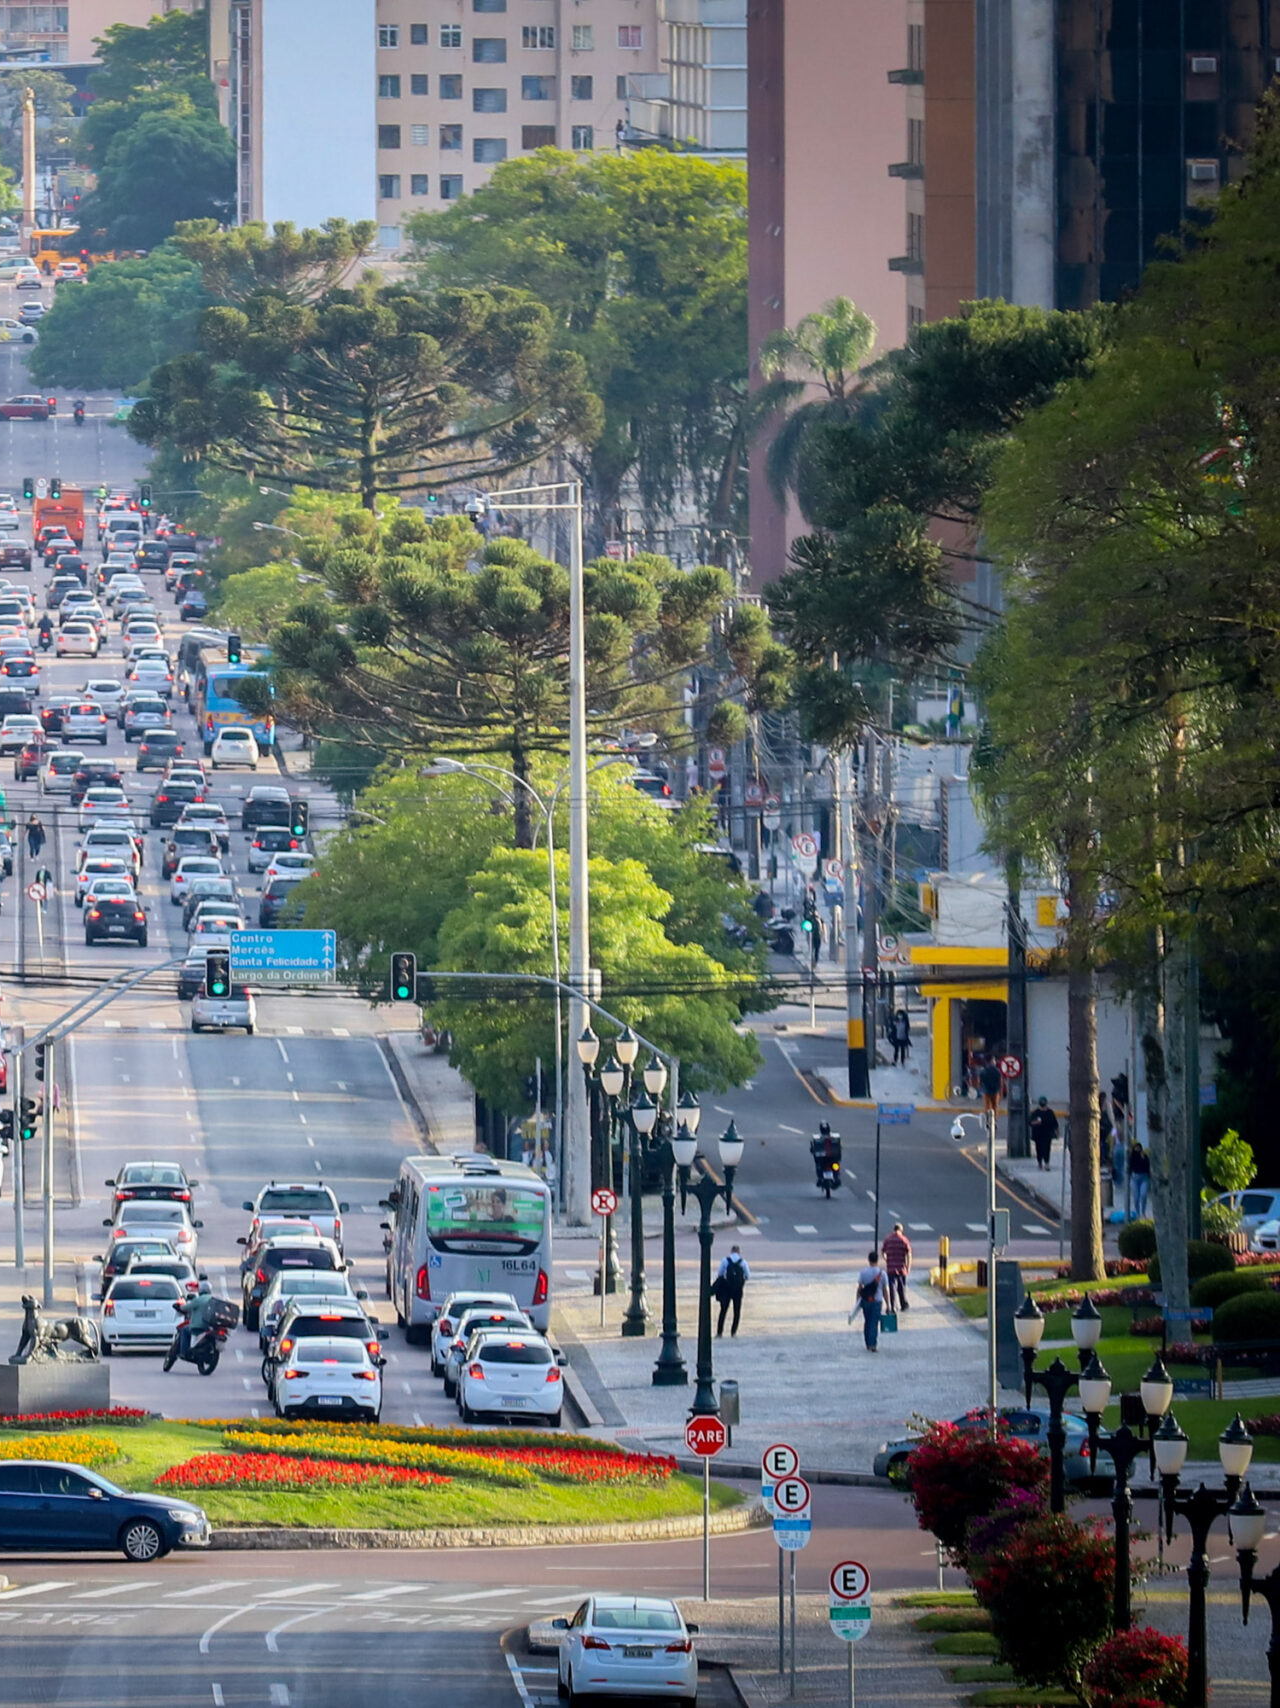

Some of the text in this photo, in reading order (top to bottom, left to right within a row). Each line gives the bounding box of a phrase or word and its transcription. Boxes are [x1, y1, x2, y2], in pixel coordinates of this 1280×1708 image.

[231, 933, 273, 943] Centro
[231, 945, 275, 954] Mercês
[231, 957, 319, 966] Santa Felicidade
[231, 971, 320, 981] Largo da Ordem
[688, 1429, 724, 1443] PARE
[774, 1452, 787, 1471] E
[785, 1484, 798, 1505] E
[843, 1569, 857, 1591] E
